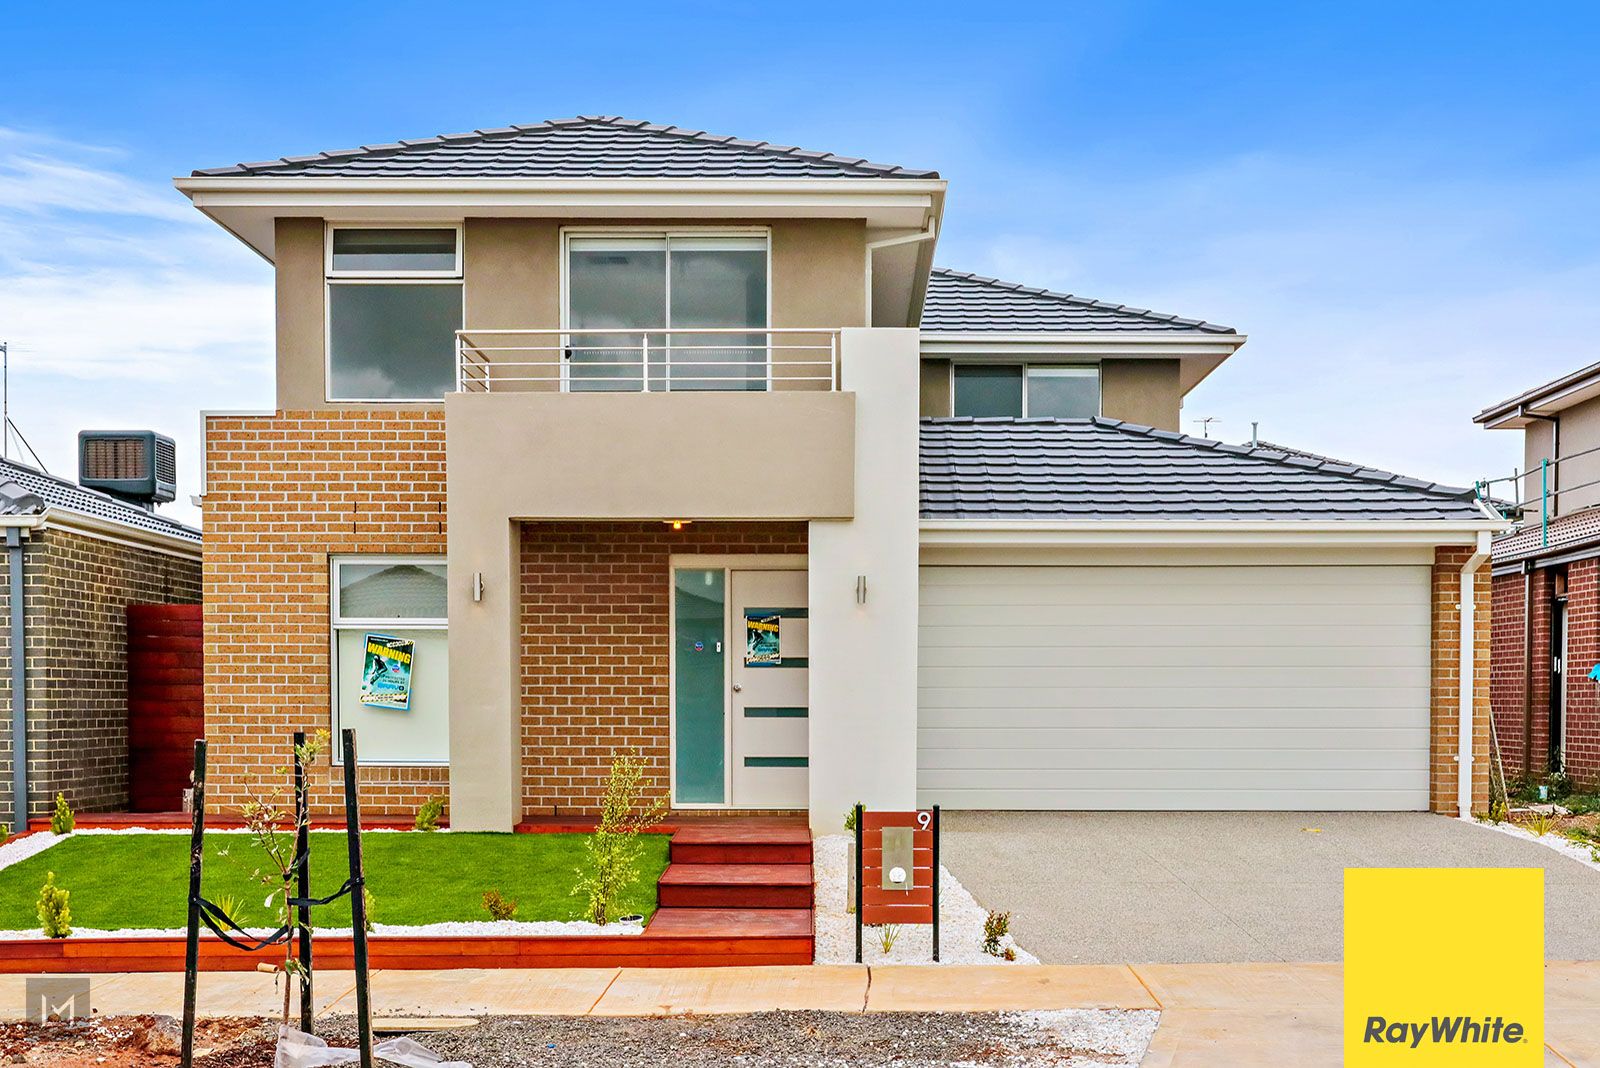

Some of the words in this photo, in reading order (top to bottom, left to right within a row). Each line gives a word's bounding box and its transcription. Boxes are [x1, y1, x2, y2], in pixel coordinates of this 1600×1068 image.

[747, 620, 779, 632] WARNING
[367, 642, 411, 664] WARNING
[917, 812, 931, 831] 9
